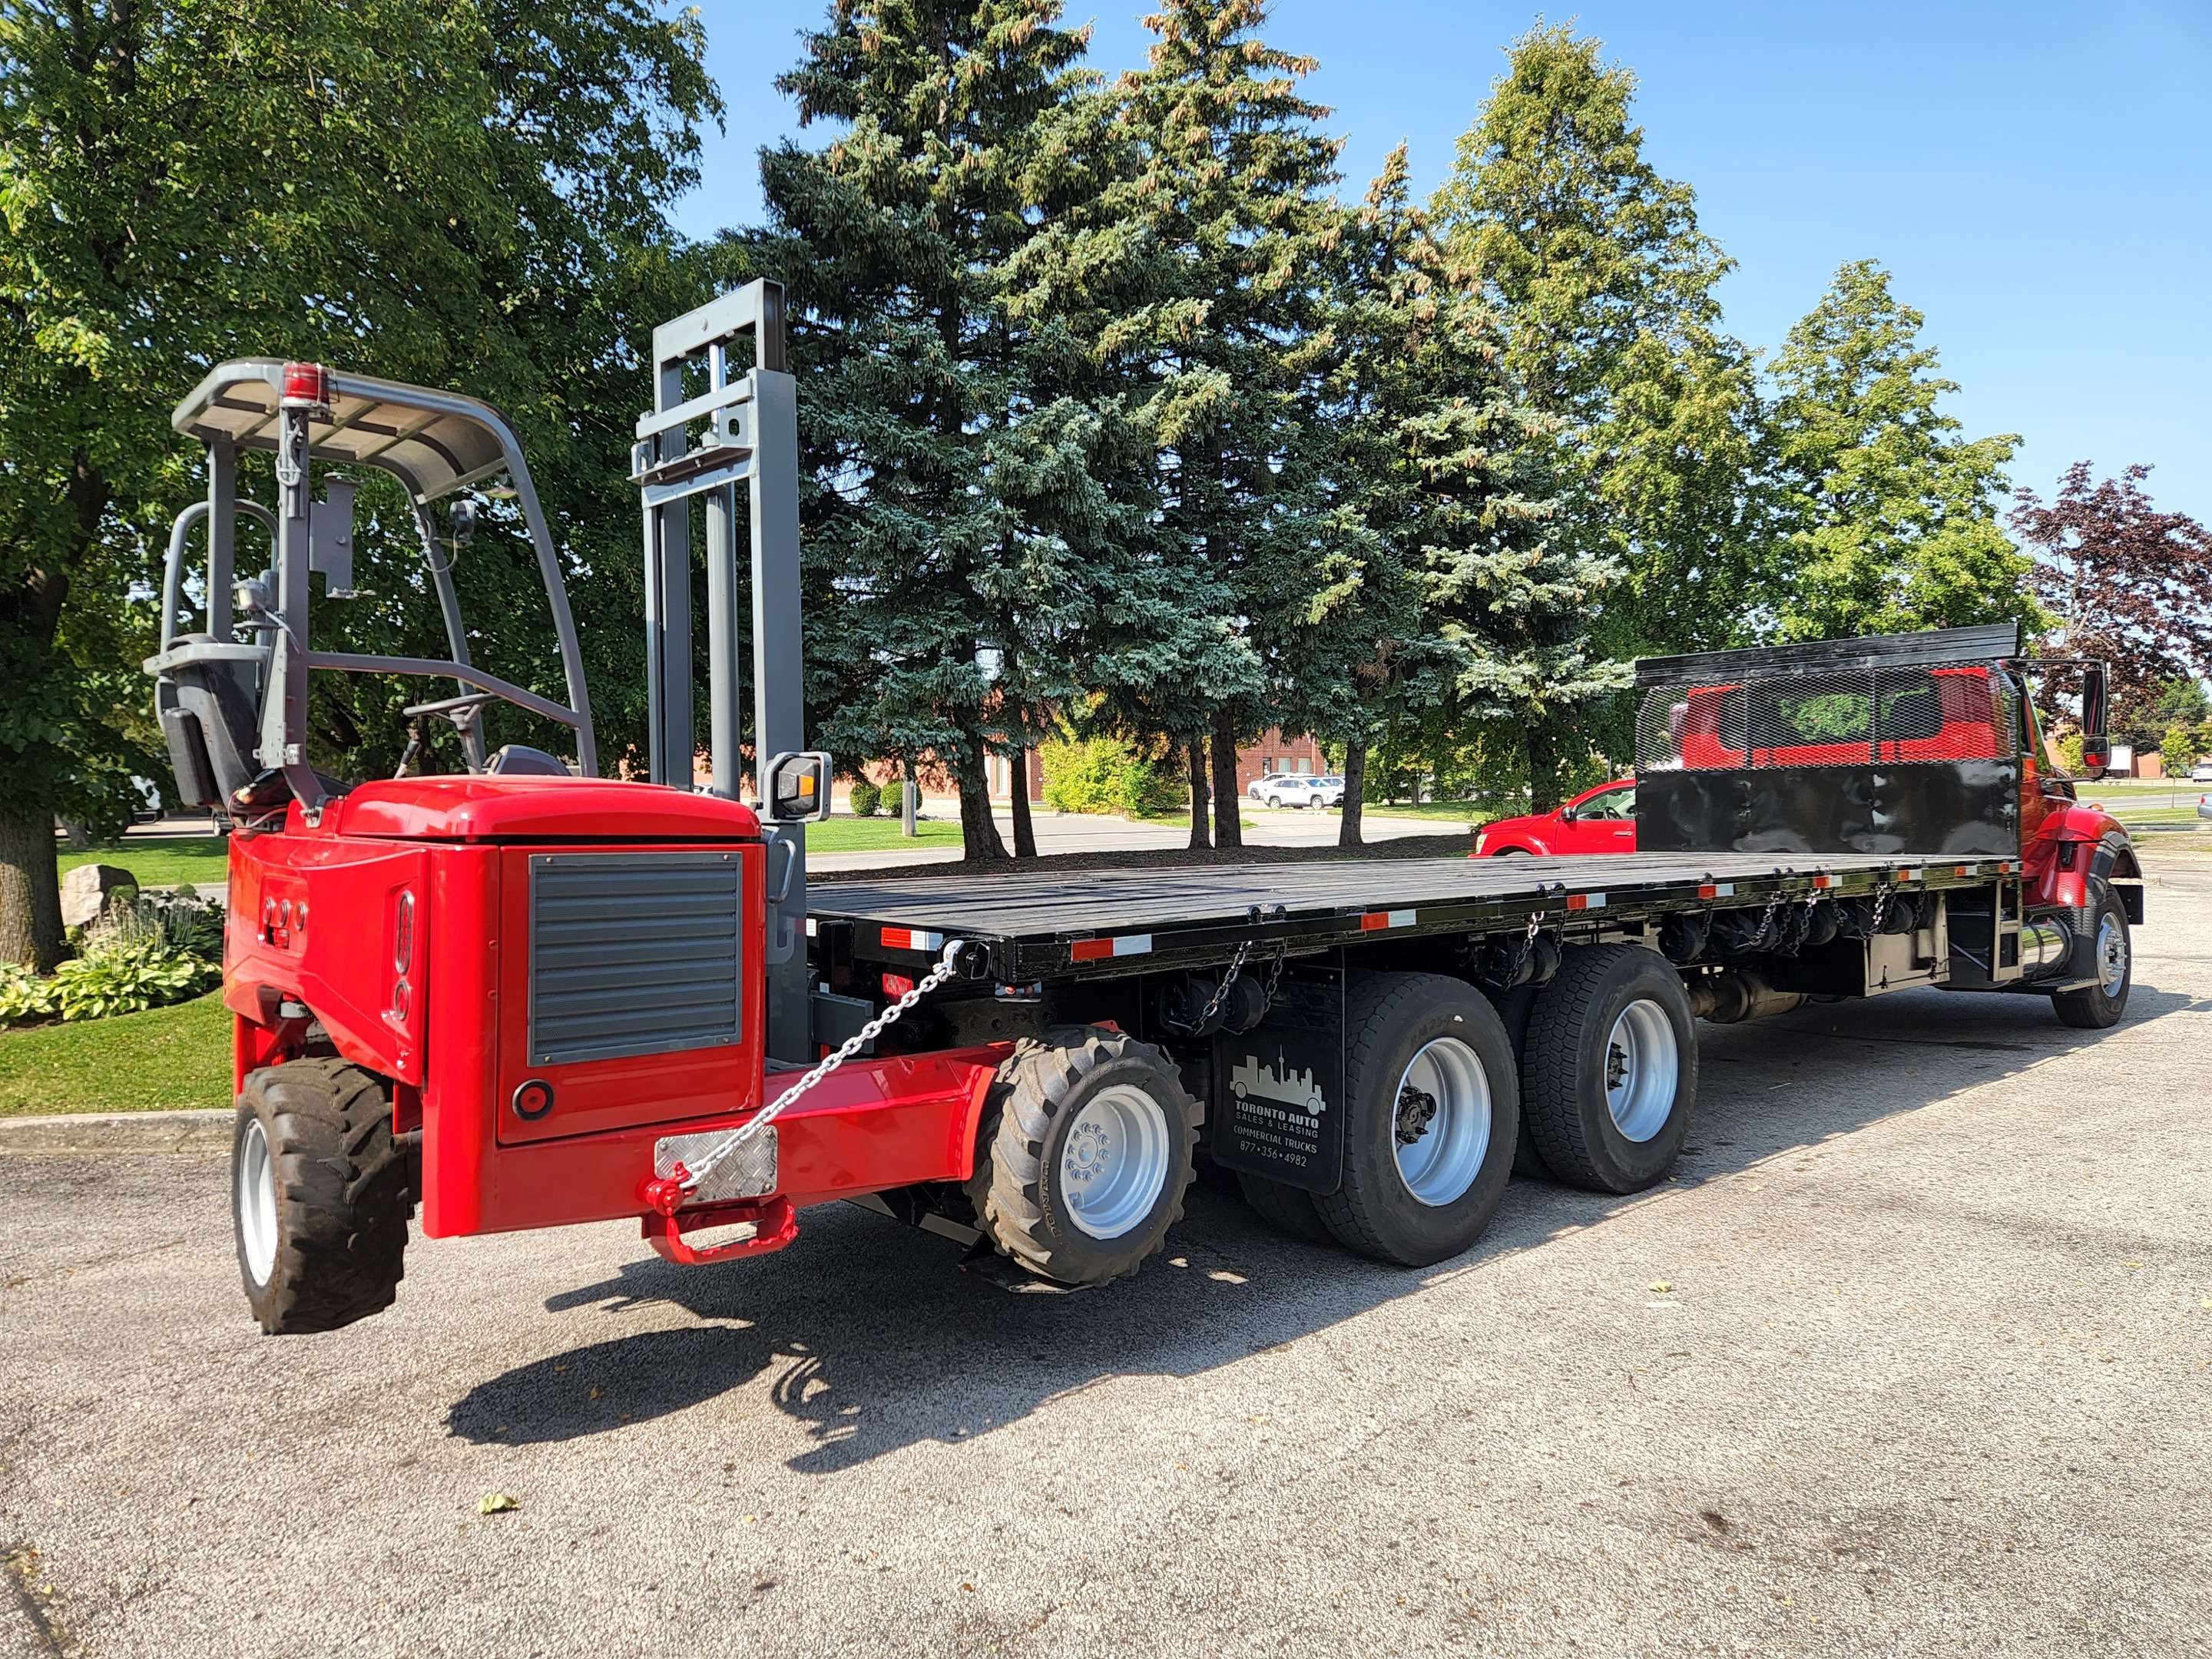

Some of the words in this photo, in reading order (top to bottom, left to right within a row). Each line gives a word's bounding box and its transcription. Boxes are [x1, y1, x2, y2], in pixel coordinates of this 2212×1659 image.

[1235, 1100, 1286, 1121] TORONTO
[1288, 1113, 1319, 1129] AUTO
[1235, 1111, 1263, 1125] SALES
[1277, 1121, 1318, 1138] LEASING
[1233, 1124, 1283, 1145] COMMERCIAL
[1284, 1137, 1317, 1154] TRUCKS
